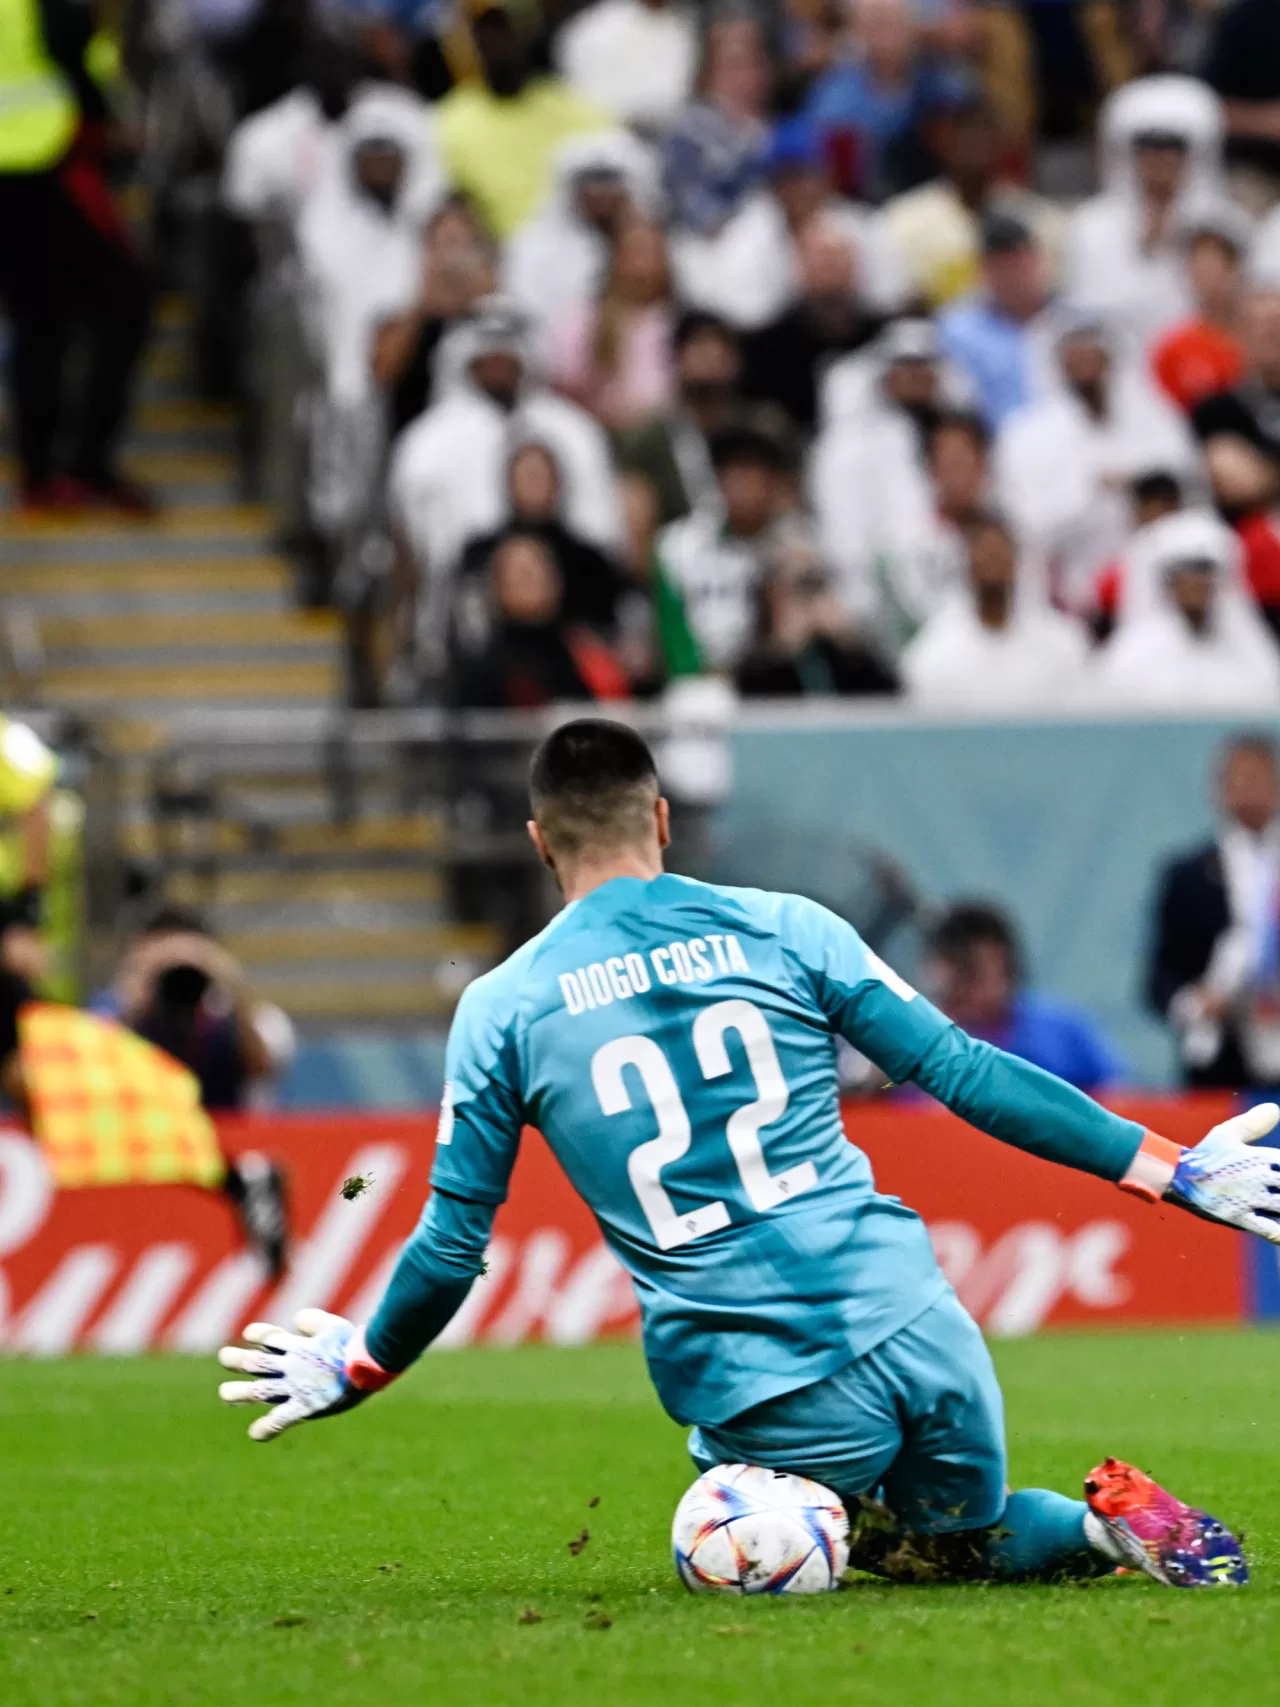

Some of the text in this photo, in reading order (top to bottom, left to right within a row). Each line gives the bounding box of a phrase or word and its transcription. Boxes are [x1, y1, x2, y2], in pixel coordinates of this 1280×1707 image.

[558, 934, 751, 1016] DIOGO COSTA
[590, 998, 819, 1251] 22
